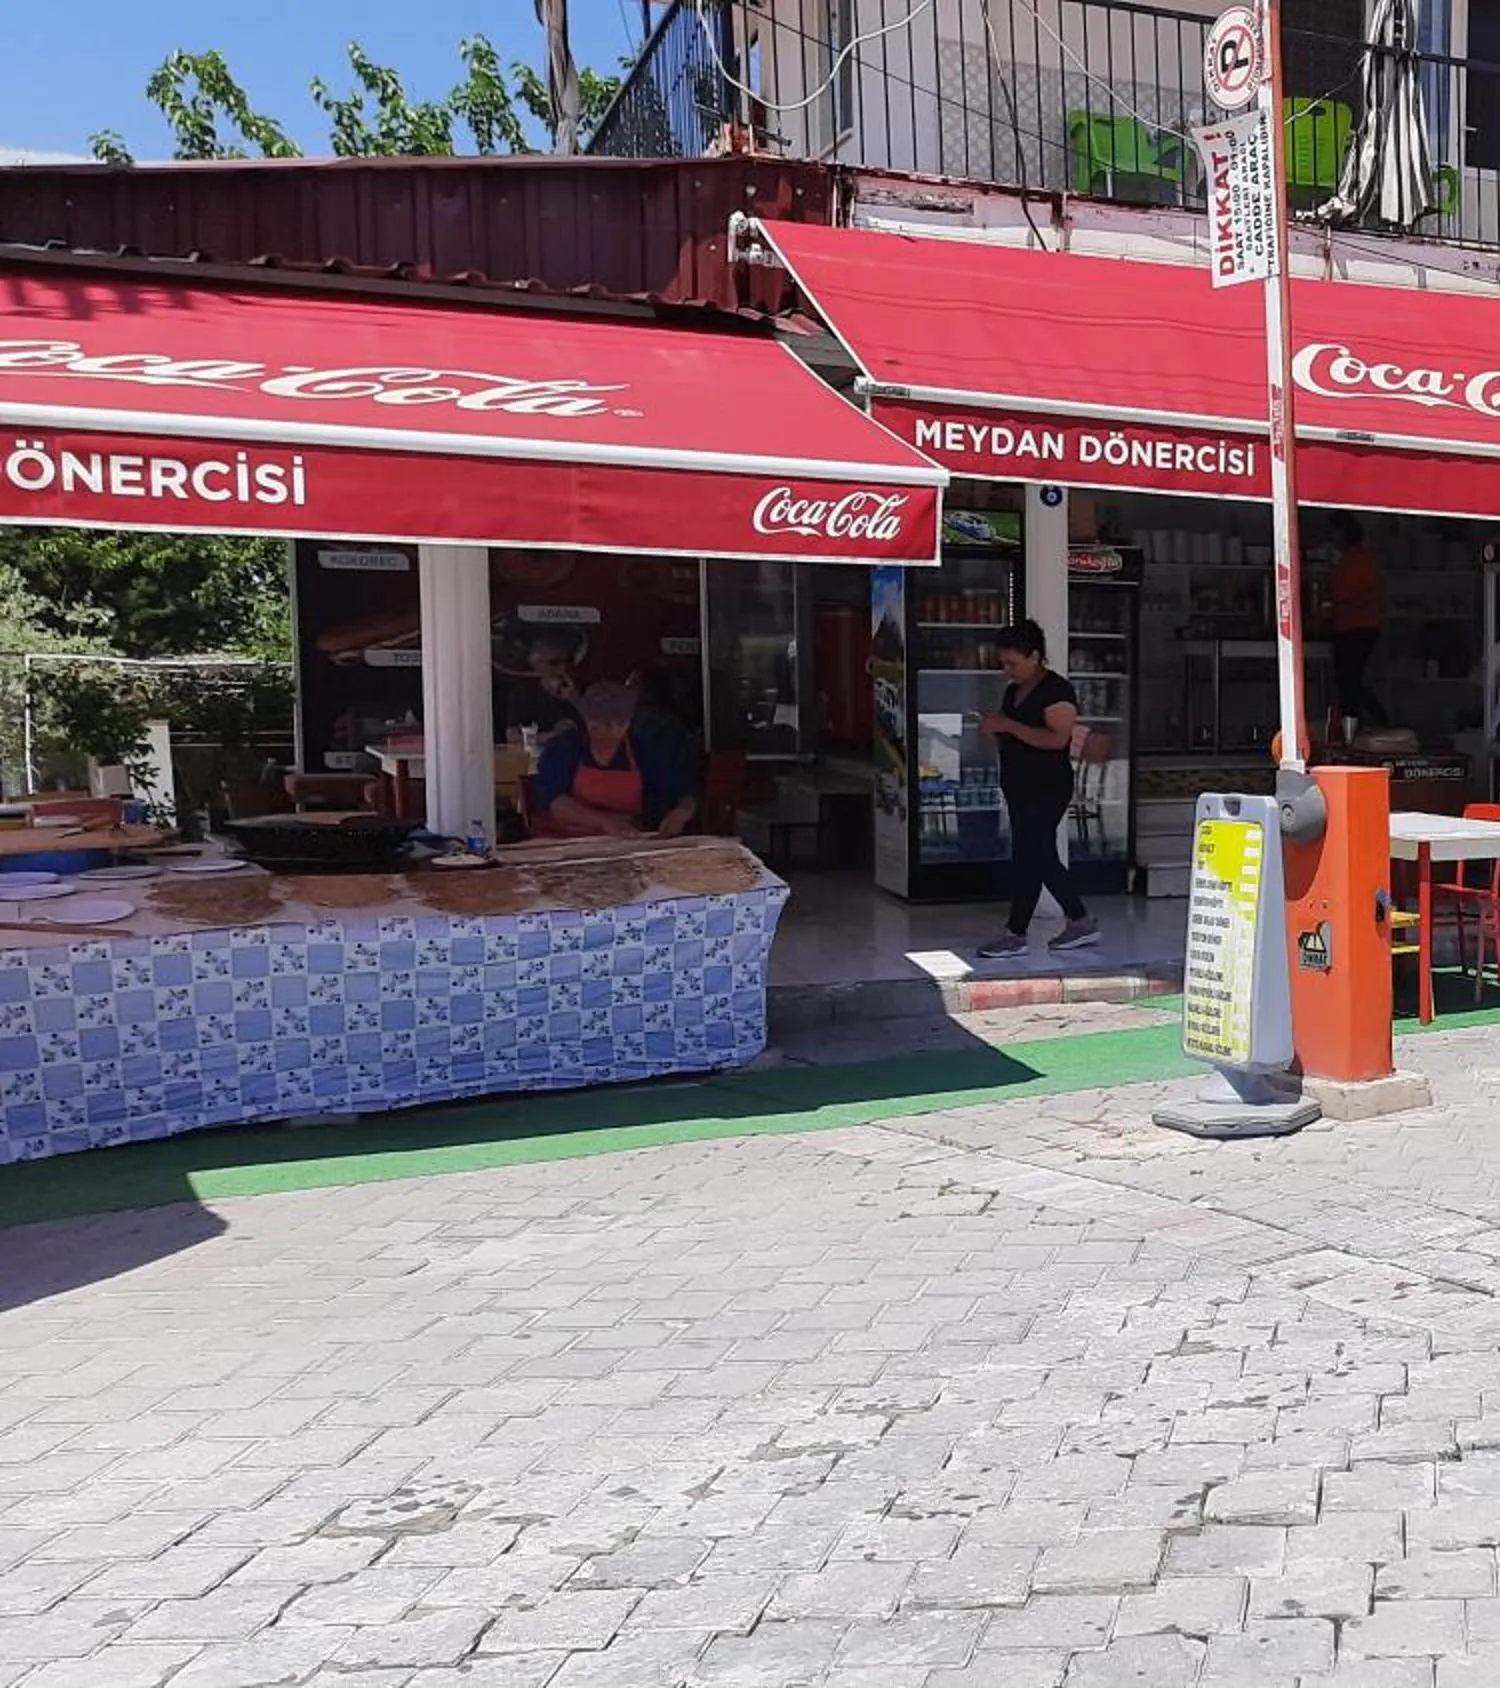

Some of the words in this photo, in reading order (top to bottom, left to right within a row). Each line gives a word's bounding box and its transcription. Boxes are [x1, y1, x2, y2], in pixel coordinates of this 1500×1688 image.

[1211, 152, 1235, 276] DİKKAT
[1232, 185, 1243, 226] 15:00
[1251, 191, 1264, 256] CADDE
[1235, 232, 1245, 271] SAAT
[914, 418, 1064, 461] MEYDAN
[1079, 431, 1255, 477] DÖNERCİSİ
[753, 486, 906, 541] Coca-Cola
